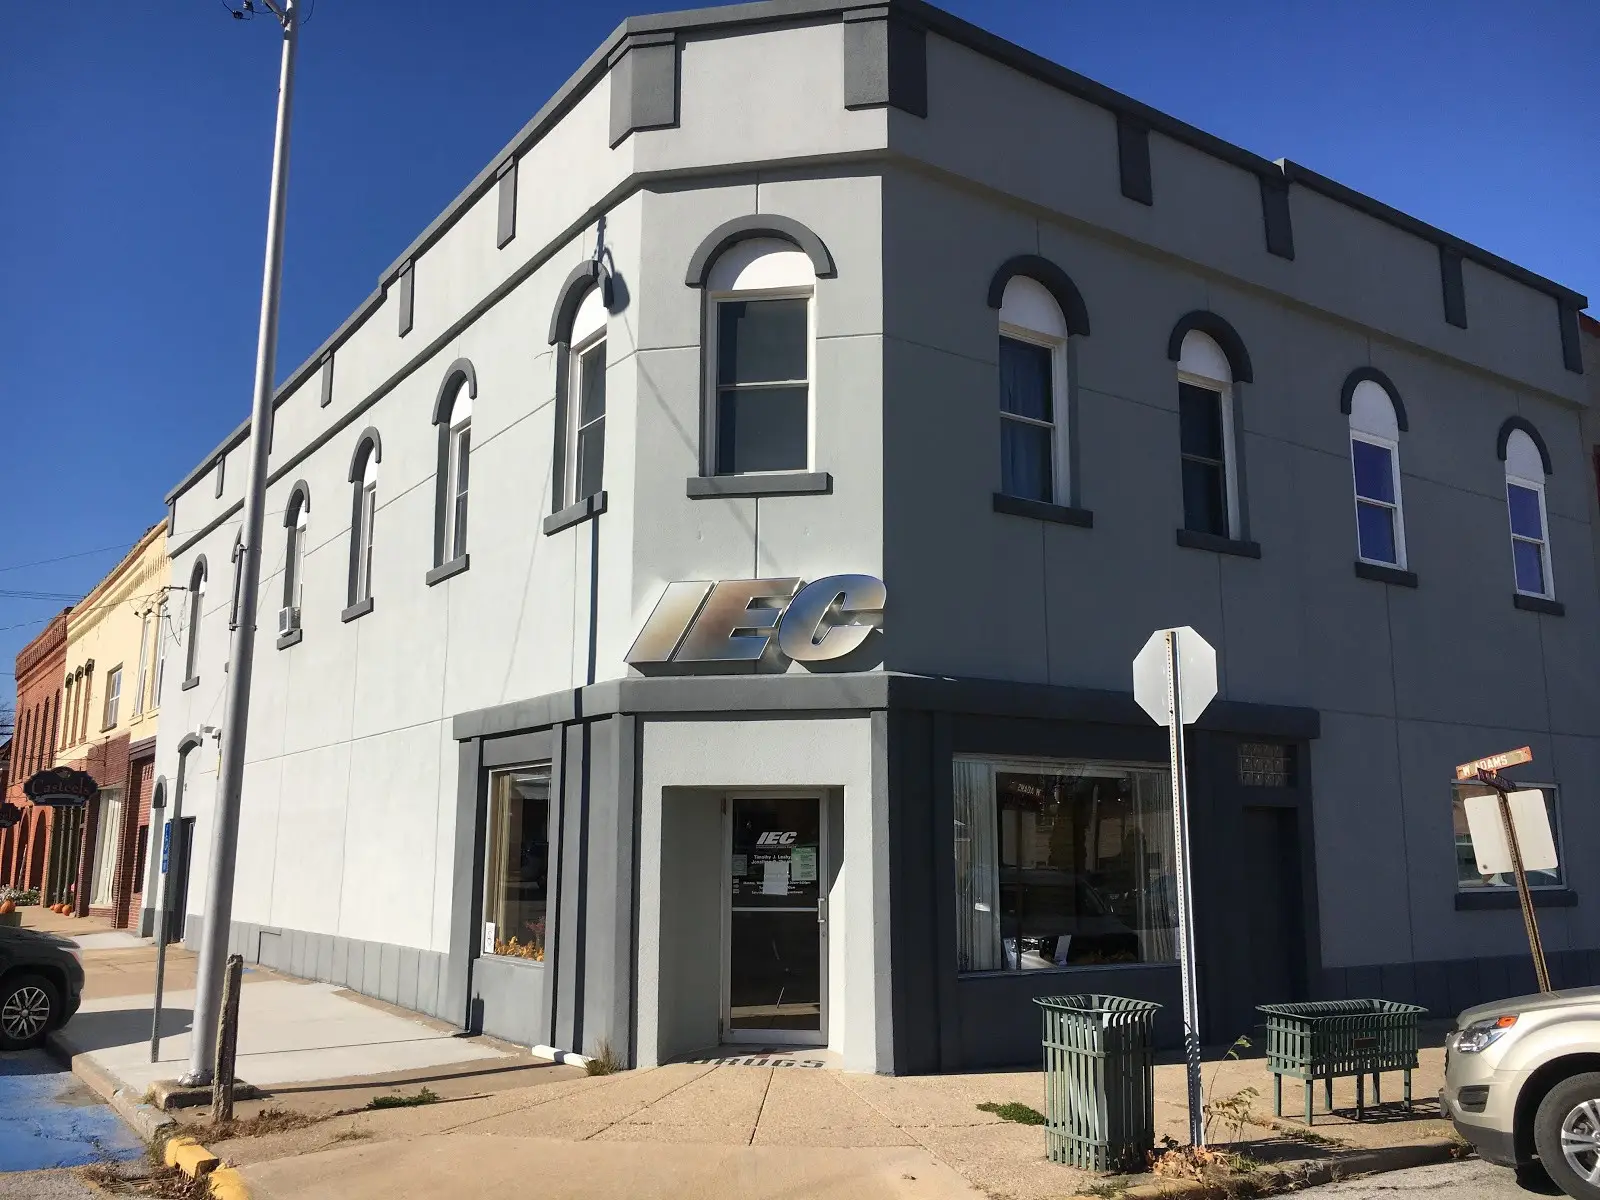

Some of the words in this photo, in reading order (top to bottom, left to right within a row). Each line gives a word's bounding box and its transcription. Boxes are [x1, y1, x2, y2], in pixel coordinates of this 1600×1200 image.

[623, 574, 887, 664] IEC
[1463, 765, 1470, 776] W
[1475, 755, 1508, 772] ADAMS
[757, 832, 797, 844] IEC
